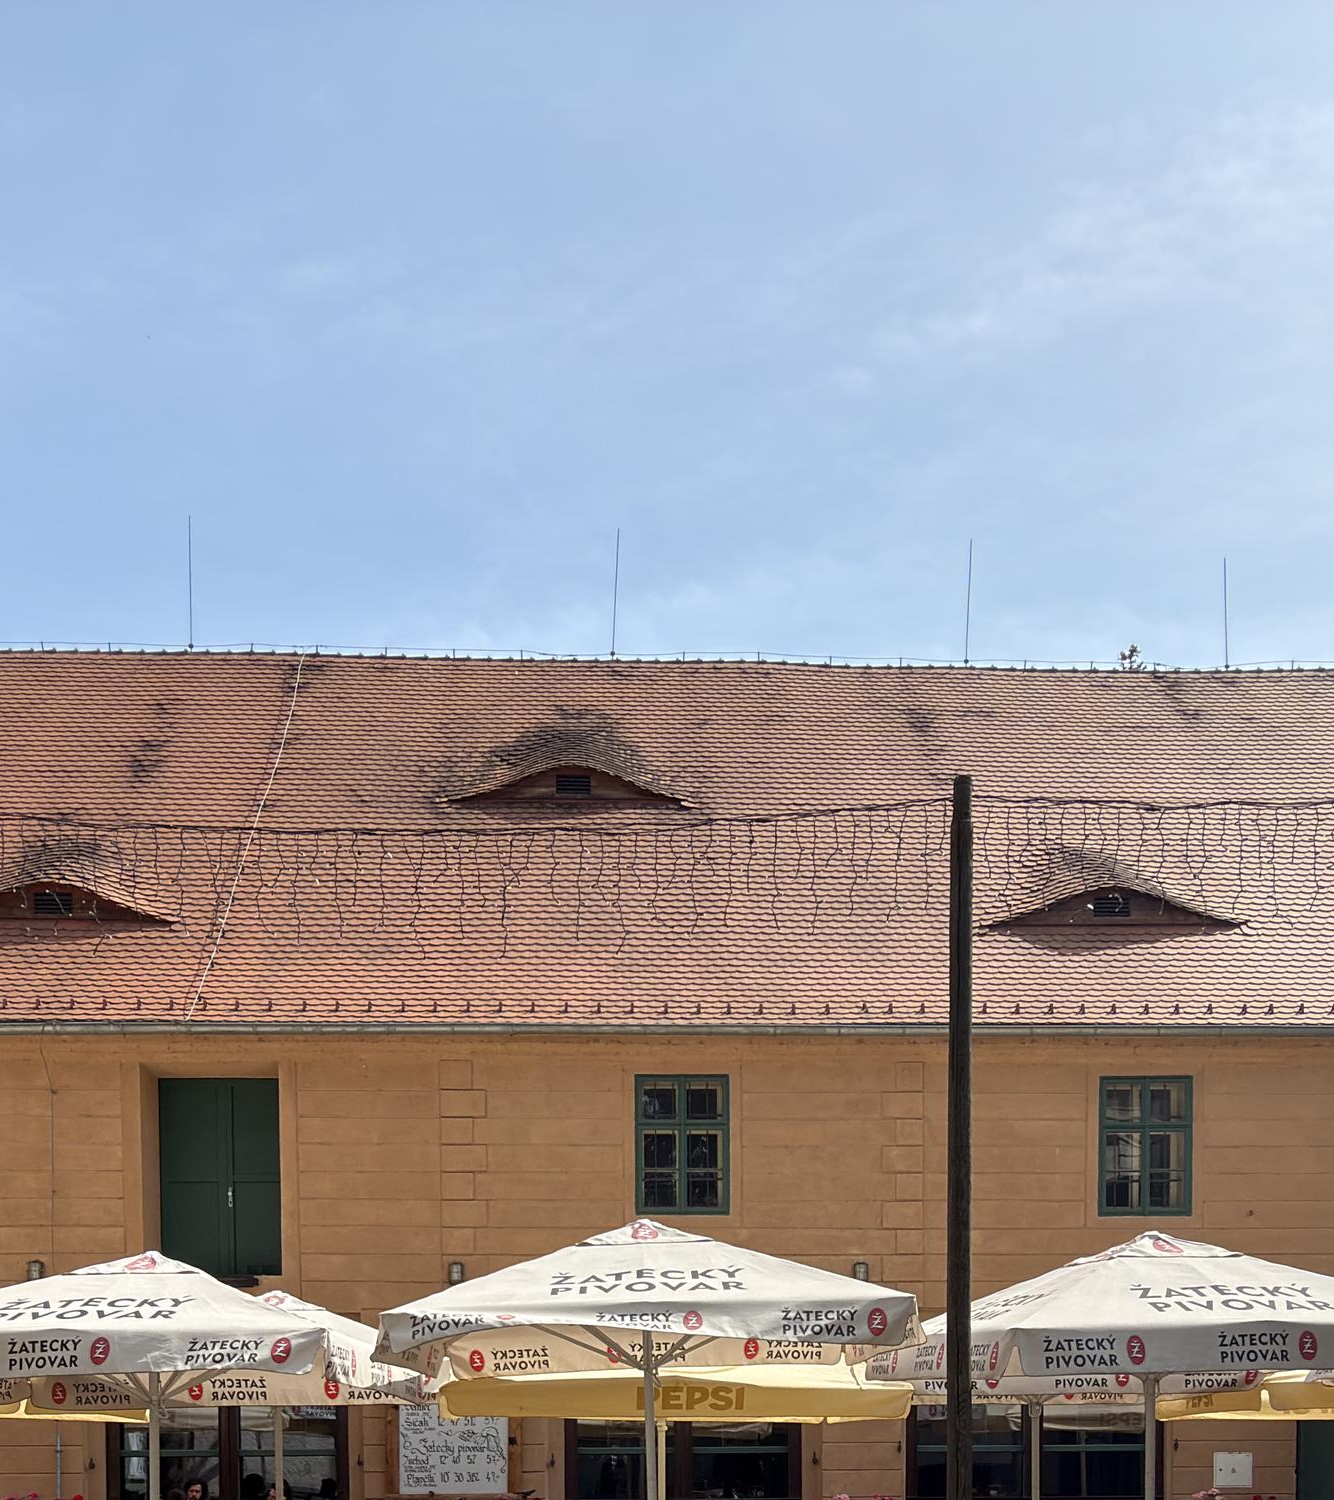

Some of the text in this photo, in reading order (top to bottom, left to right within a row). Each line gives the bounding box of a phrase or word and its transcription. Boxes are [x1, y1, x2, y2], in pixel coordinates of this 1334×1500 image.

[551, 1265, 744, 1285] ŽATECKÝ
[550, 1281, 748, 1295] PIVOVAR
[1130, 1283, 1315, 1299] ŽATECKÝ
[596, 1310, 673, 1323] ŽATECKÝ
[781, 1306, 858, 1321] ŽATECKÝ
[411, 1317, 485, 1340] PIVOVAR
[782, 1324, 856, 1337] PIVOVAR
[7, 1336, 82, 1355] ŽATECKÝ
[187, 1338, 264, 1352] ŽATECKÝ
[1043, 1335, 1116, 1352] ŽATECKÝ
[1218, 1330, 1289, 1347] ŽATECKÝ
[9, 1356, 79, 1371] PIVOVAR
[185, 1353, 257, 1366] PIVOVAR
[1045, 1354, 1119, 1369] PIVOVAR
[1220, 1350, 1290, 1363] PIVOVAR
[1055, 1378, 1108, 1388] PIVOVAR
[1184, 1378, 1237, 1389] PIVOVAR
